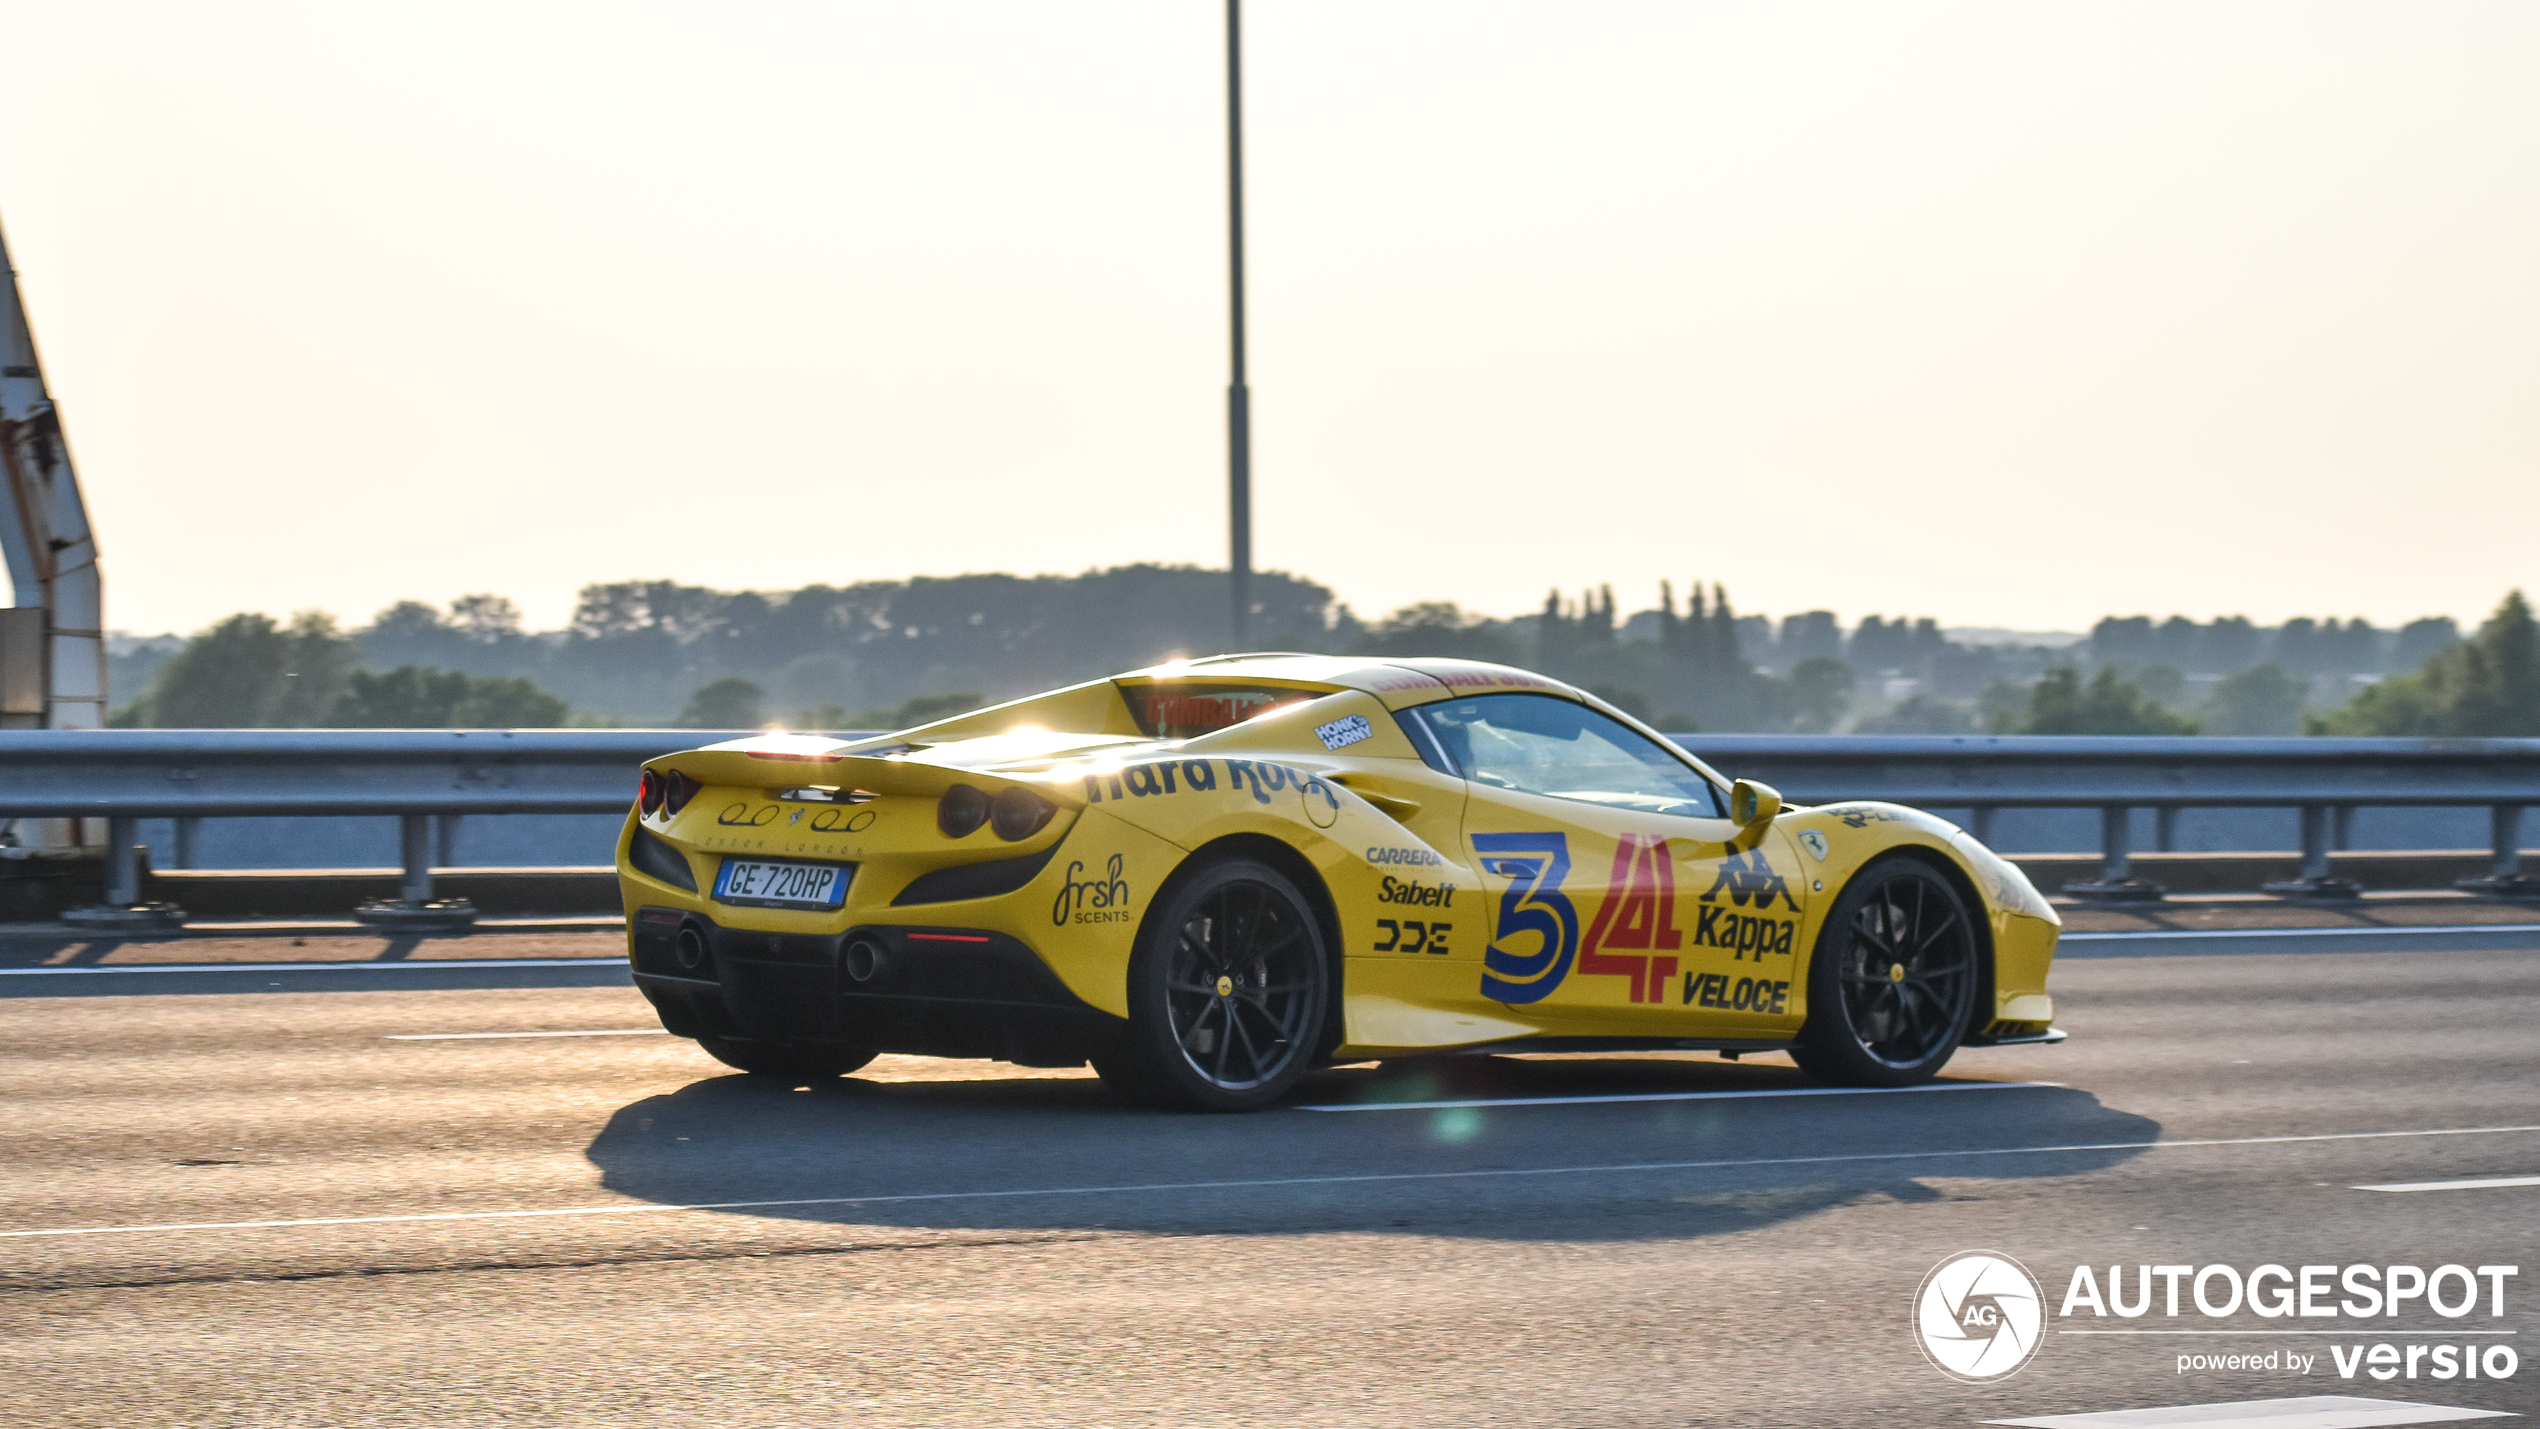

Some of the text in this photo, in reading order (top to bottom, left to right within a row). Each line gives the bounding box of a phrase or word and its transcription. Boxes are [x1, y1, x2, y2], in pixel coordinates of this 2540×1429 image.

[1314, 714, 1359, 740] HONK
[1323, 725, 1373, 751] HORNY
[1366, 847, 1442, 866] CARRERA
[729, 864, 761, 895] GE
[761, 866, 833, 899] 720HP
[1053, 853, 1128, 926] frsh
[1378, 875, 1455, 908] Sabelt
[1075, 911, 1130, 924] SCENTS
[1470, 831, 1683, 1005] 34
[1693, 904, 1795, 962] Kappa
[1682, 971, 1790, 1014] VELOCE
